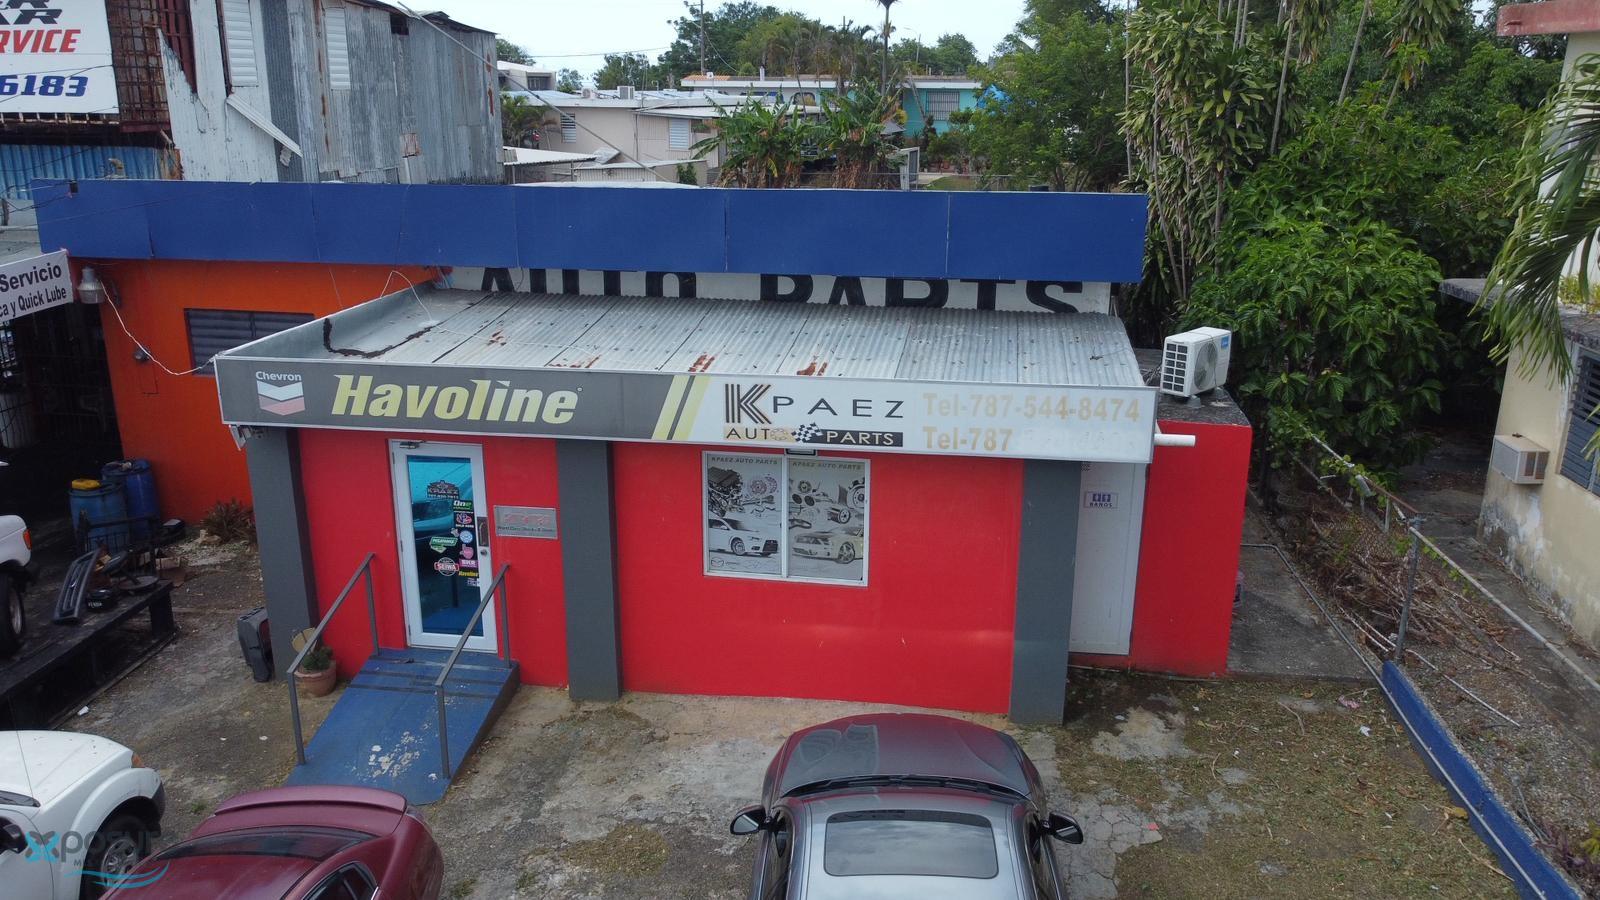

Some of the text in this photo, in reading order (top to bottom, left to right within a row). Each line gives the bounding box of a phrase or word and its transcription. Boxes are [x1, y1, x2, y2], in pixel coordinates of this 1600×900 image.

[0, 262, 62, 292] Servicio
[10, 301, 16, 317] y
[18, 290, 44, 311] Quick
[45, 285, 67, 302] Lube
[255, 371, 302, 381] Chevron
[330, 374, 579, 424] Havoline
[826, 431, 894, 445] PARTS
[922, 426, 1013, 451] Tel-787
